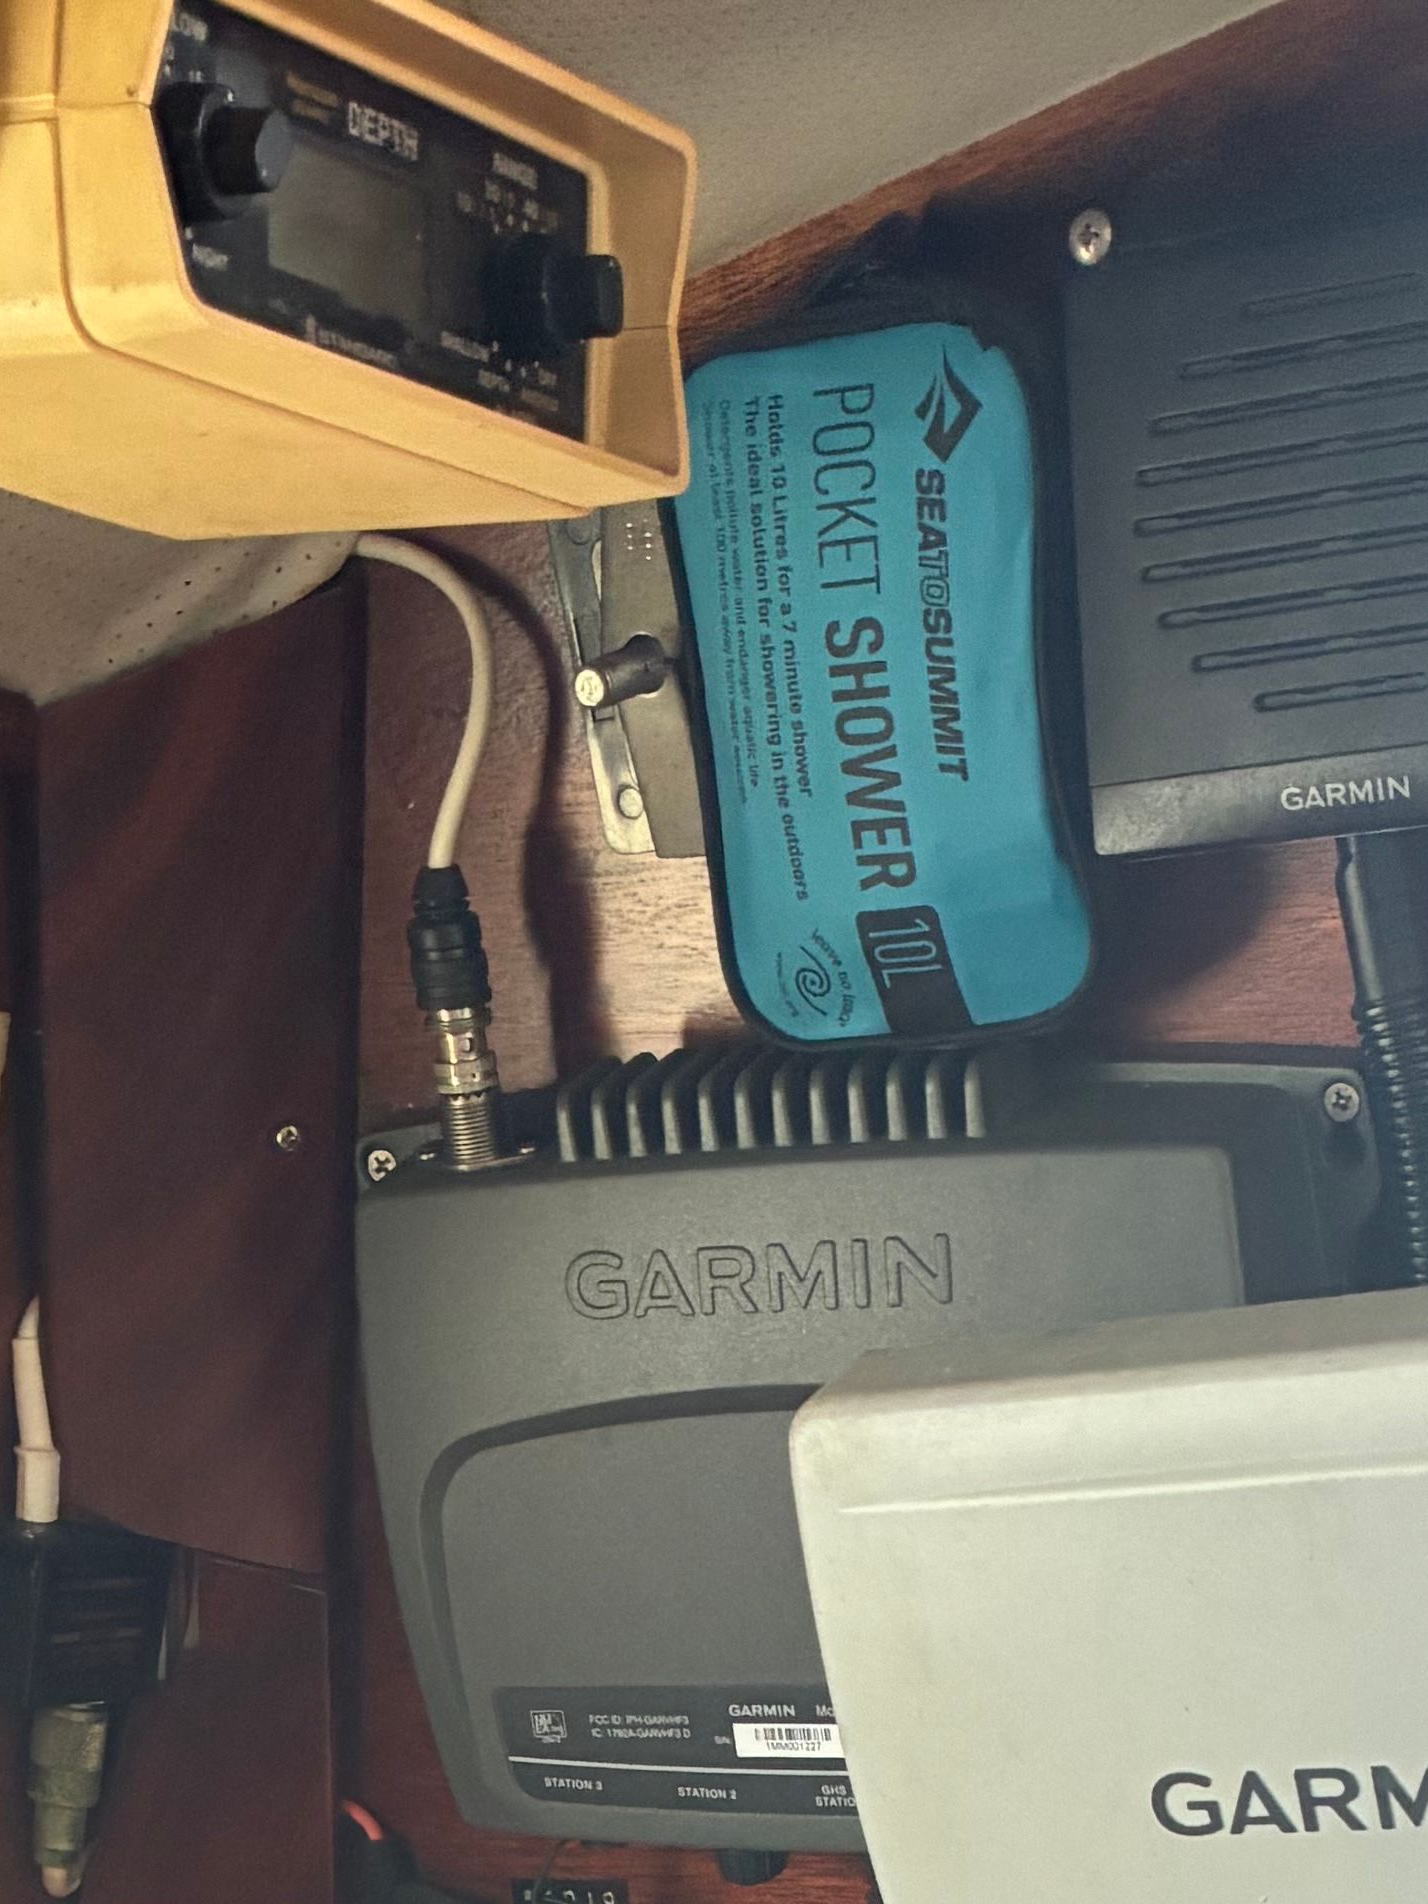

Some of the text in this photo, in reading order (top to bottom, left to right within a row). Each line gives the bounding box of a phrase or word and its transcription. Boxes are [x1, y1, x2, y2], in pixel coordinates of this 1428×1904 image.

[348, 101, 420, 161] DEPTH
[767, 394, 813, 799] Holds 10 Litres for a 7 minute shower
[744, 396, 810, 901] The ideal solution for showering in the outdoors
[812, 382, 918, 892] POCKET SHOWER
[1280, 775, 1411, 811] GARMIN
[868, 917, 944, 990] 10L
[564, 1232, 954, 1321] GARMIN
[728, 1704, 796, 1718] GARMIN
[544, 1776, 592, 1791] STATION
[677, 1786, 727, 1799] STATION
[815, 1796, 857, 1808] STATIO
